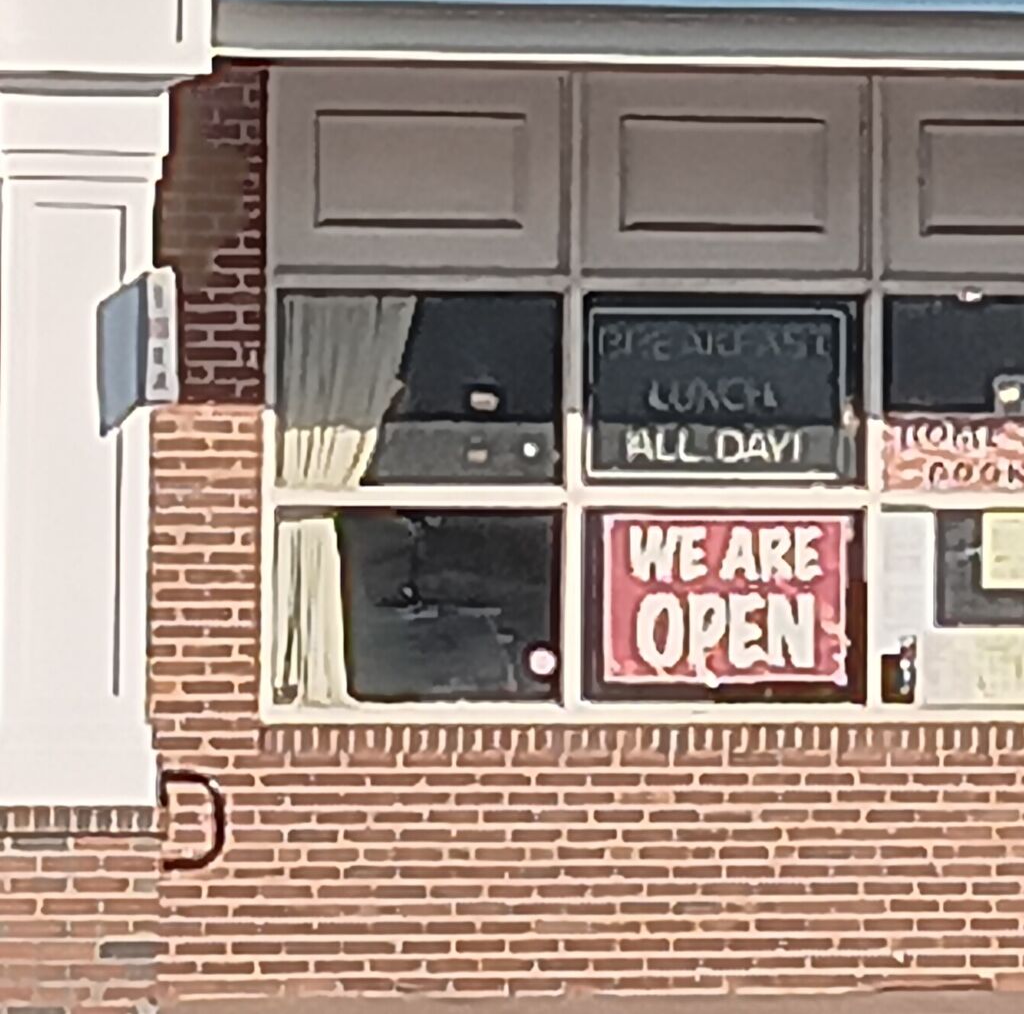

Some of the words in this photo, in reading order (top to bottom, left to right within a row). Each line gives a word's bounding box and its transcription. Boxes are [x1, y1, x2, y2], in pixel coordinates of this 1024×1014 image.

[649, 376, 779, 413] LUNCH
[626, 426, 712, 464] ALL
[629, 525, 709, 583] WE
[719, 525, 824, 583] ARE
[636, 591, 815, 670] OPEN
